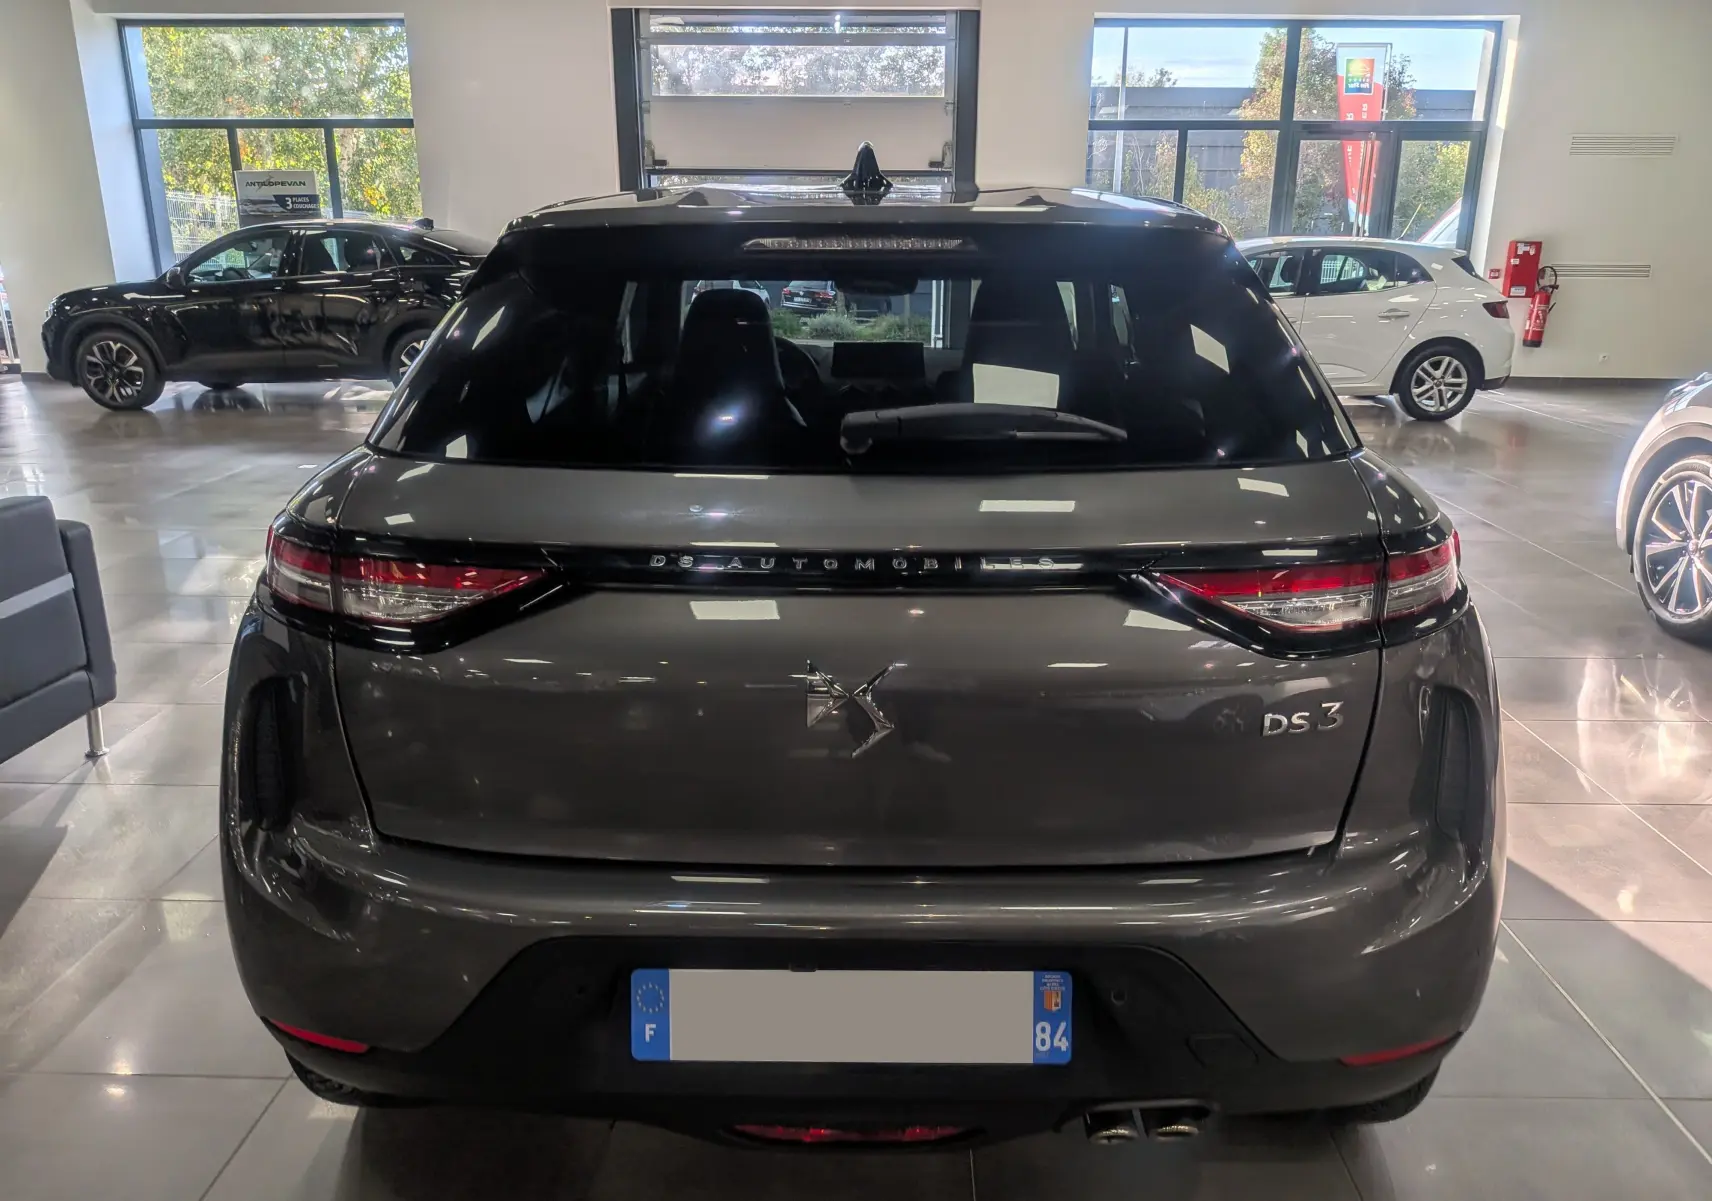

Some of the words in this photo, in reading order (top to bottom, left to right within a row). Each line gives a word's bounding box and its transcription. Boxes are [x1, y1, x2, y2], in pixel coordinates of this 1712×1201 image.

[285, 197, 292, 210] 3
[650, 554, 693, 567] DS
[728, 556, 1055, 570] AUTOMOBILES
[1262, 712, 1310, 736] DS
[1318, 701, 1344, 731] 3
[646, 1024, 656, 1042] F
[1035, 1021, 1069, 1052] 84
